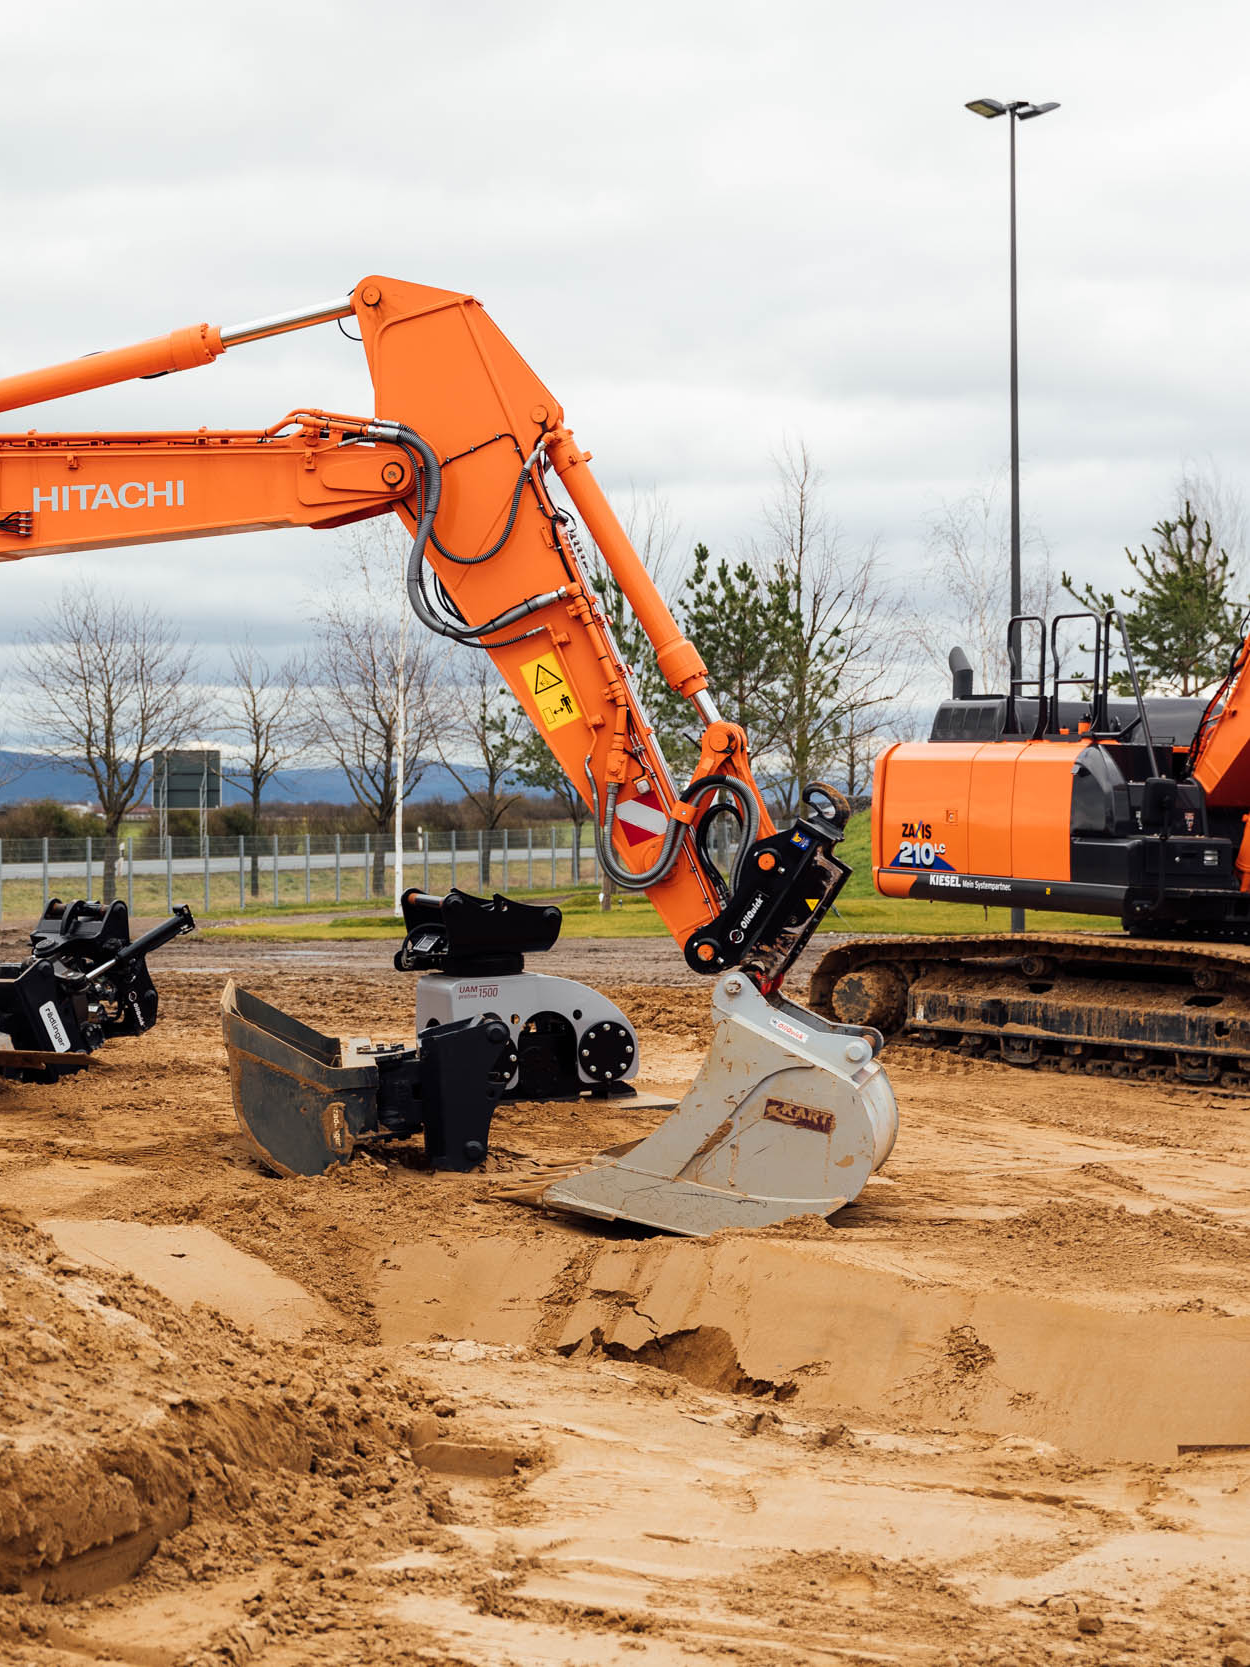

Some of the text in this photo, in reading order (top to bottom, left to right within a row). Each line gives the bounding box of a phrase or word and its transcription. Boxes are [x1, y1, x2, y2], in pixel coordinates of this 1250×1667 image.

[33, 480, 185, 512] HITACHI
[901, 820, 932, 839] ZAXIS
[929, 874, 1012, 892] KIESEL Mein Systempartner.
[740, 896, 764, 930] OilQuick
[459, 985, 498, 998] UAM 1500
[45, 1007, 66, 1047] rädlinger
